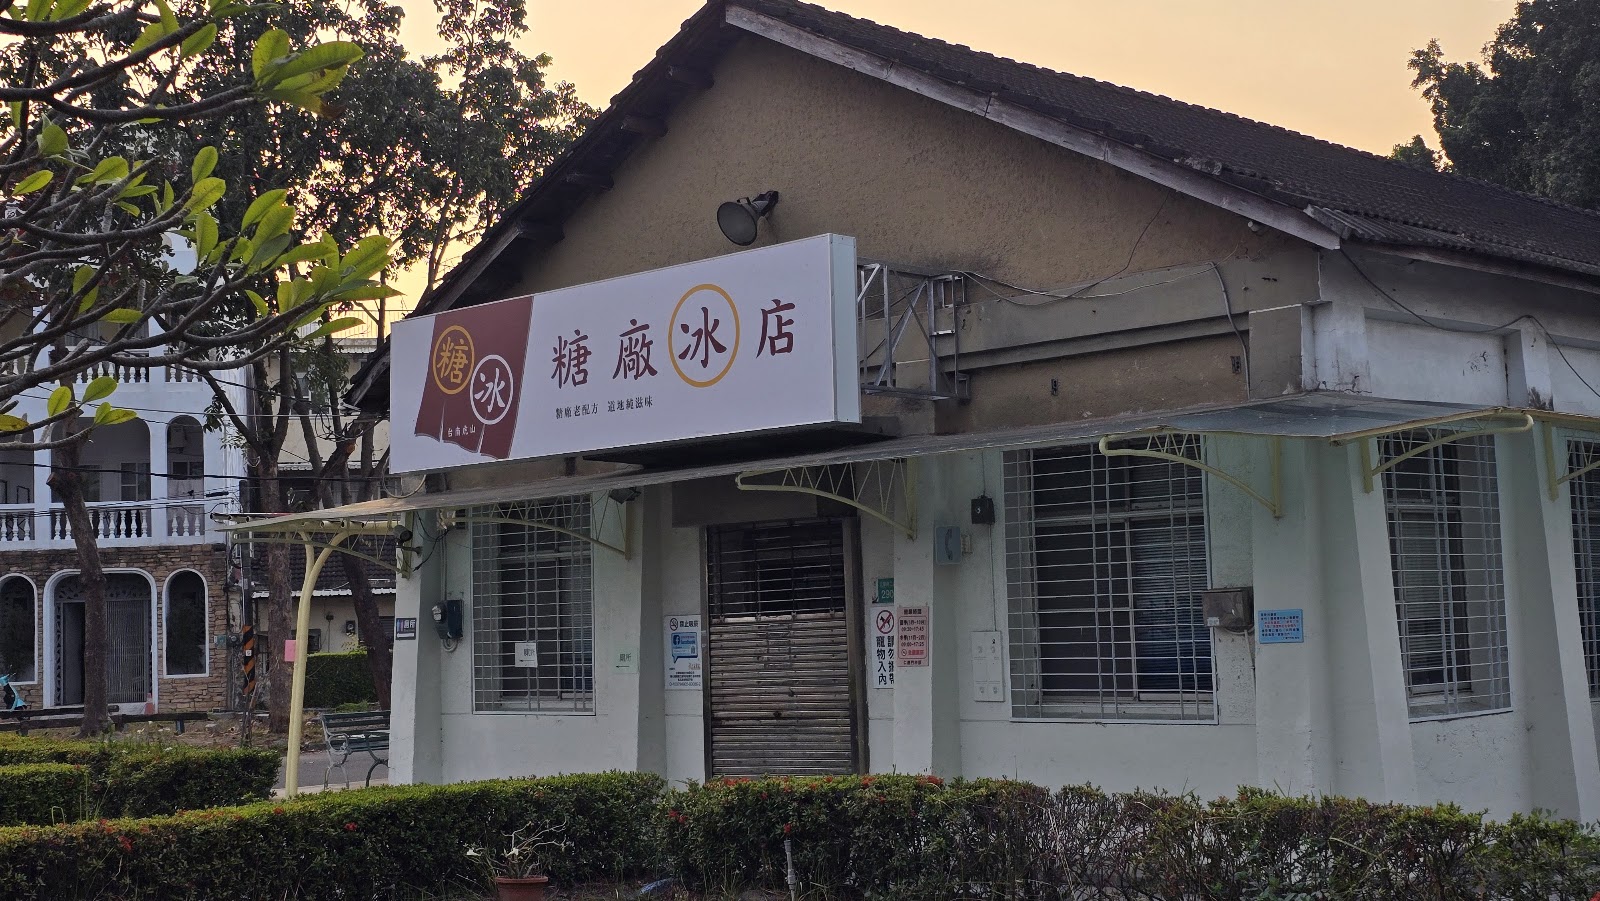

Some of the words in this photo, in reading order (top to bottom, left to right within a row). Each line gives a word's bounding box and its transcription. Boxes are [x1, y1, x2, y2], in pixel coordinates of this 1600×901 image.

[437, 337, 469, 385] 糖
[551, 298, 796, 390] 糖廠冰店
[475, 367, 507, 414] 冰
[876, 636, 887, 685] 寵物入內
